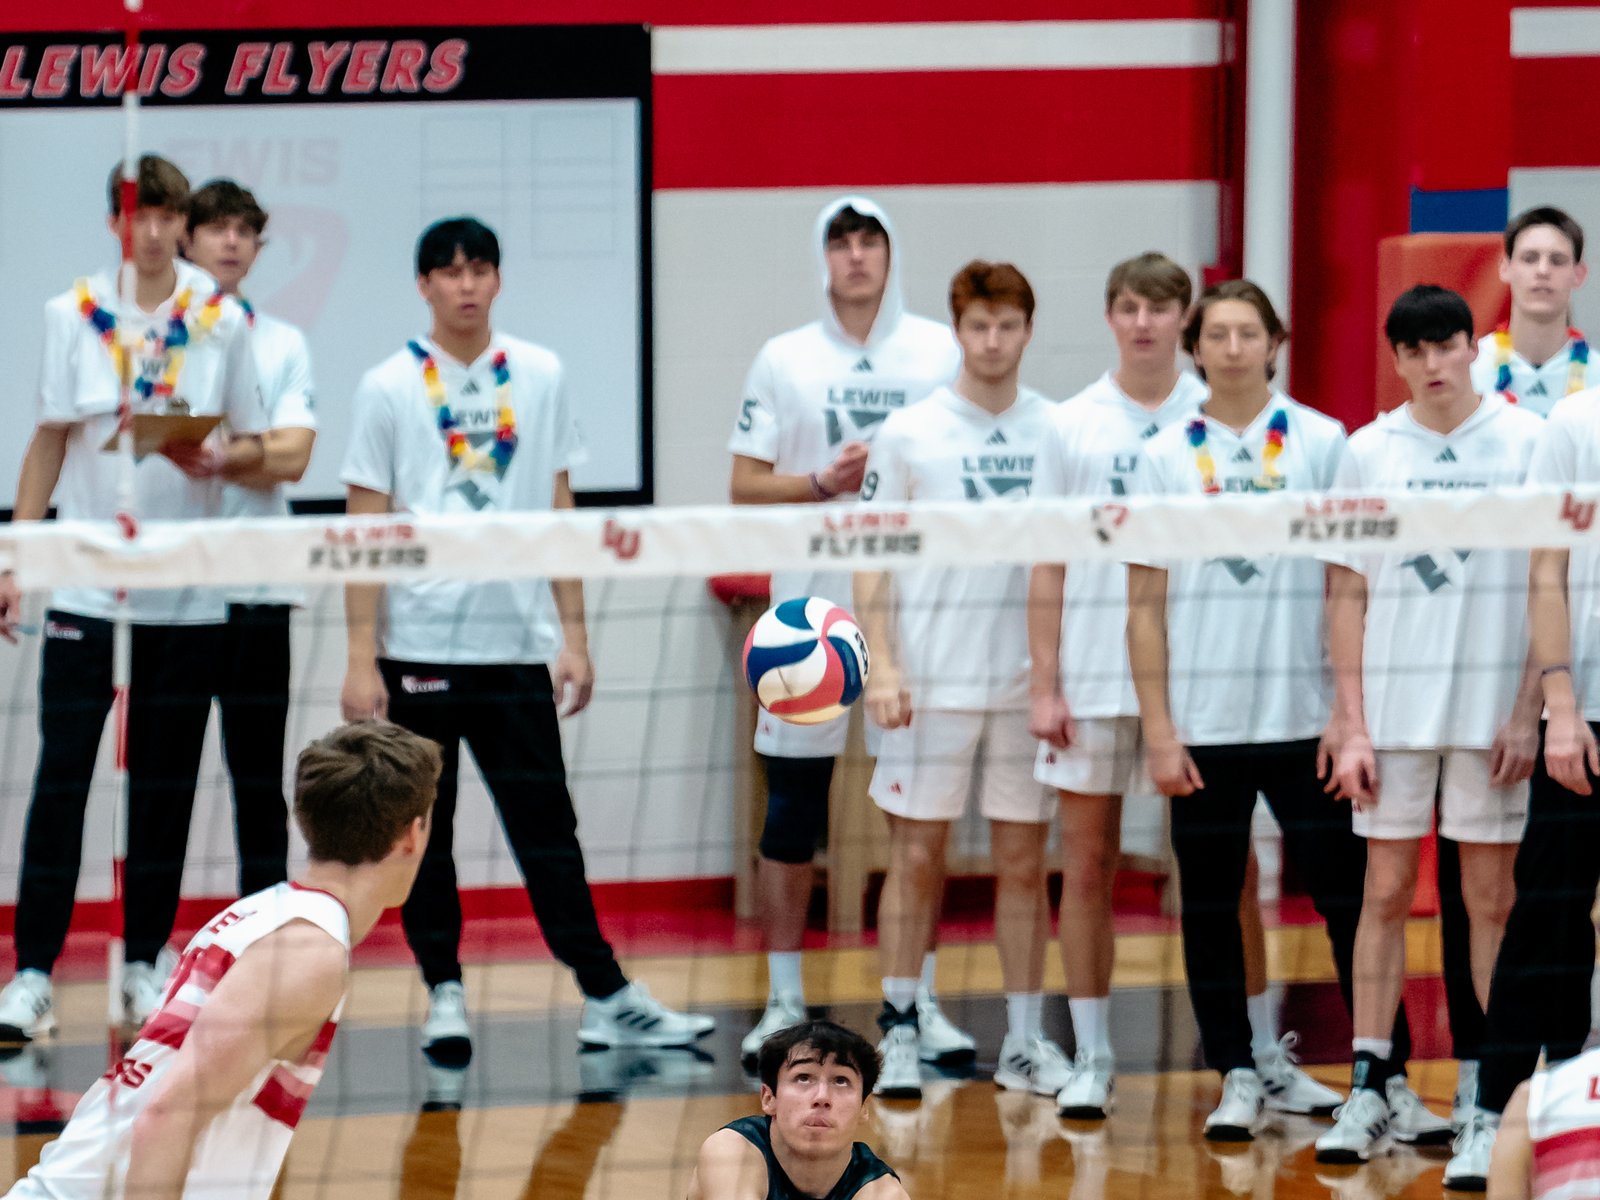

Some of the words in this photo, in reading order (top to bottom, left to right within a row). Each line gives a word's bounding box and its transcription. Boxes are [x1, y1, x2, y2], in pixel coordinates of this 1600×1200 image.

[0, 43, 206, 99] LEWIS
[224, 38, 470, 96] FLYERS
[737, 398, 759, 433] 5
[828, 387, 906, 409] LEWIS
